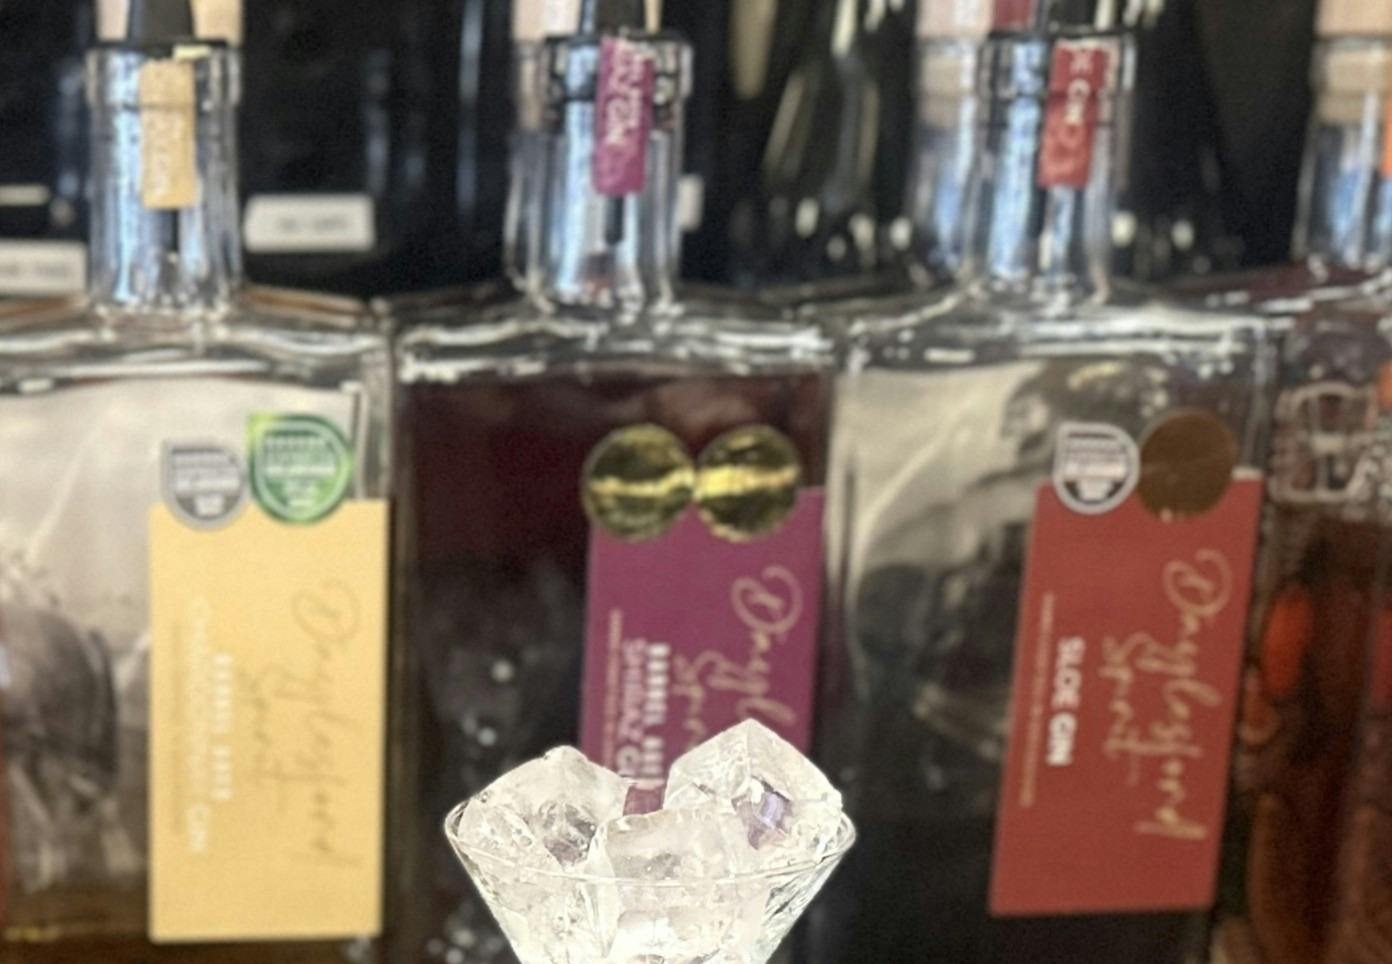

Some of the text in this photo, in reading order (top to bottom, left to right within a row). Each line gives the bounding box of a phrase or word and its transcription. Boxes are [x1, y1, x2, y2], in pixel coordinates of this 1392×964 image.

[1045, 635, 1087, 767] SLOE GIN
[1099, 631, 1151, 787] Spirit
[1132, 548, 1234, 841] Daylesford
